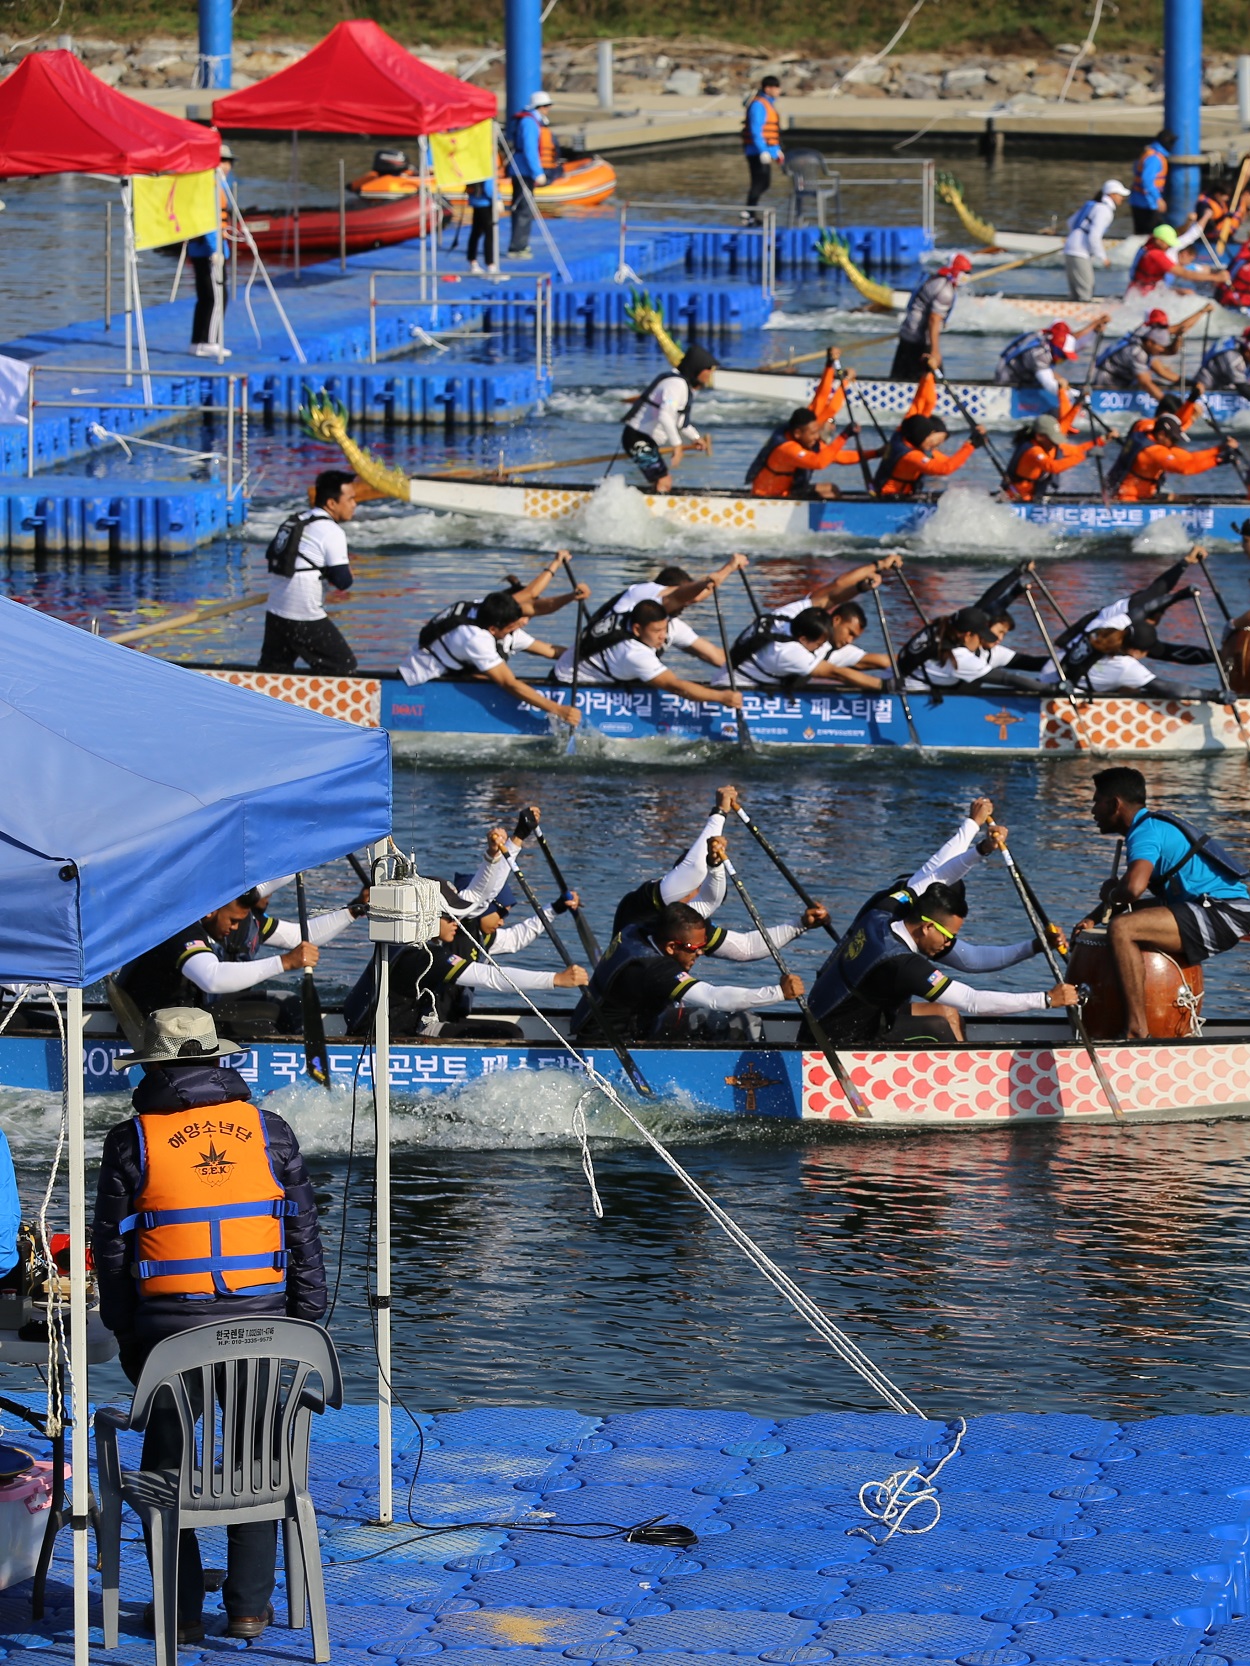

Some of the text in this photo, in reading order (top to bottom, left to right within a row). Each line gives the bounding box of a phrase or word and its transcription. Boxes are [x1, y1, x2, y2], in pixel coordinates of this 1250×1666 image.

[1099, 392, 1133, 409] 2017
[575, 691, 652, 717] 아라뱃길
[810, 697, 893, 723] 페스티벌
[167, 1120, 253, 1149] 해양소년단
[216, 1328, 245, 1340] 한국렌탈
